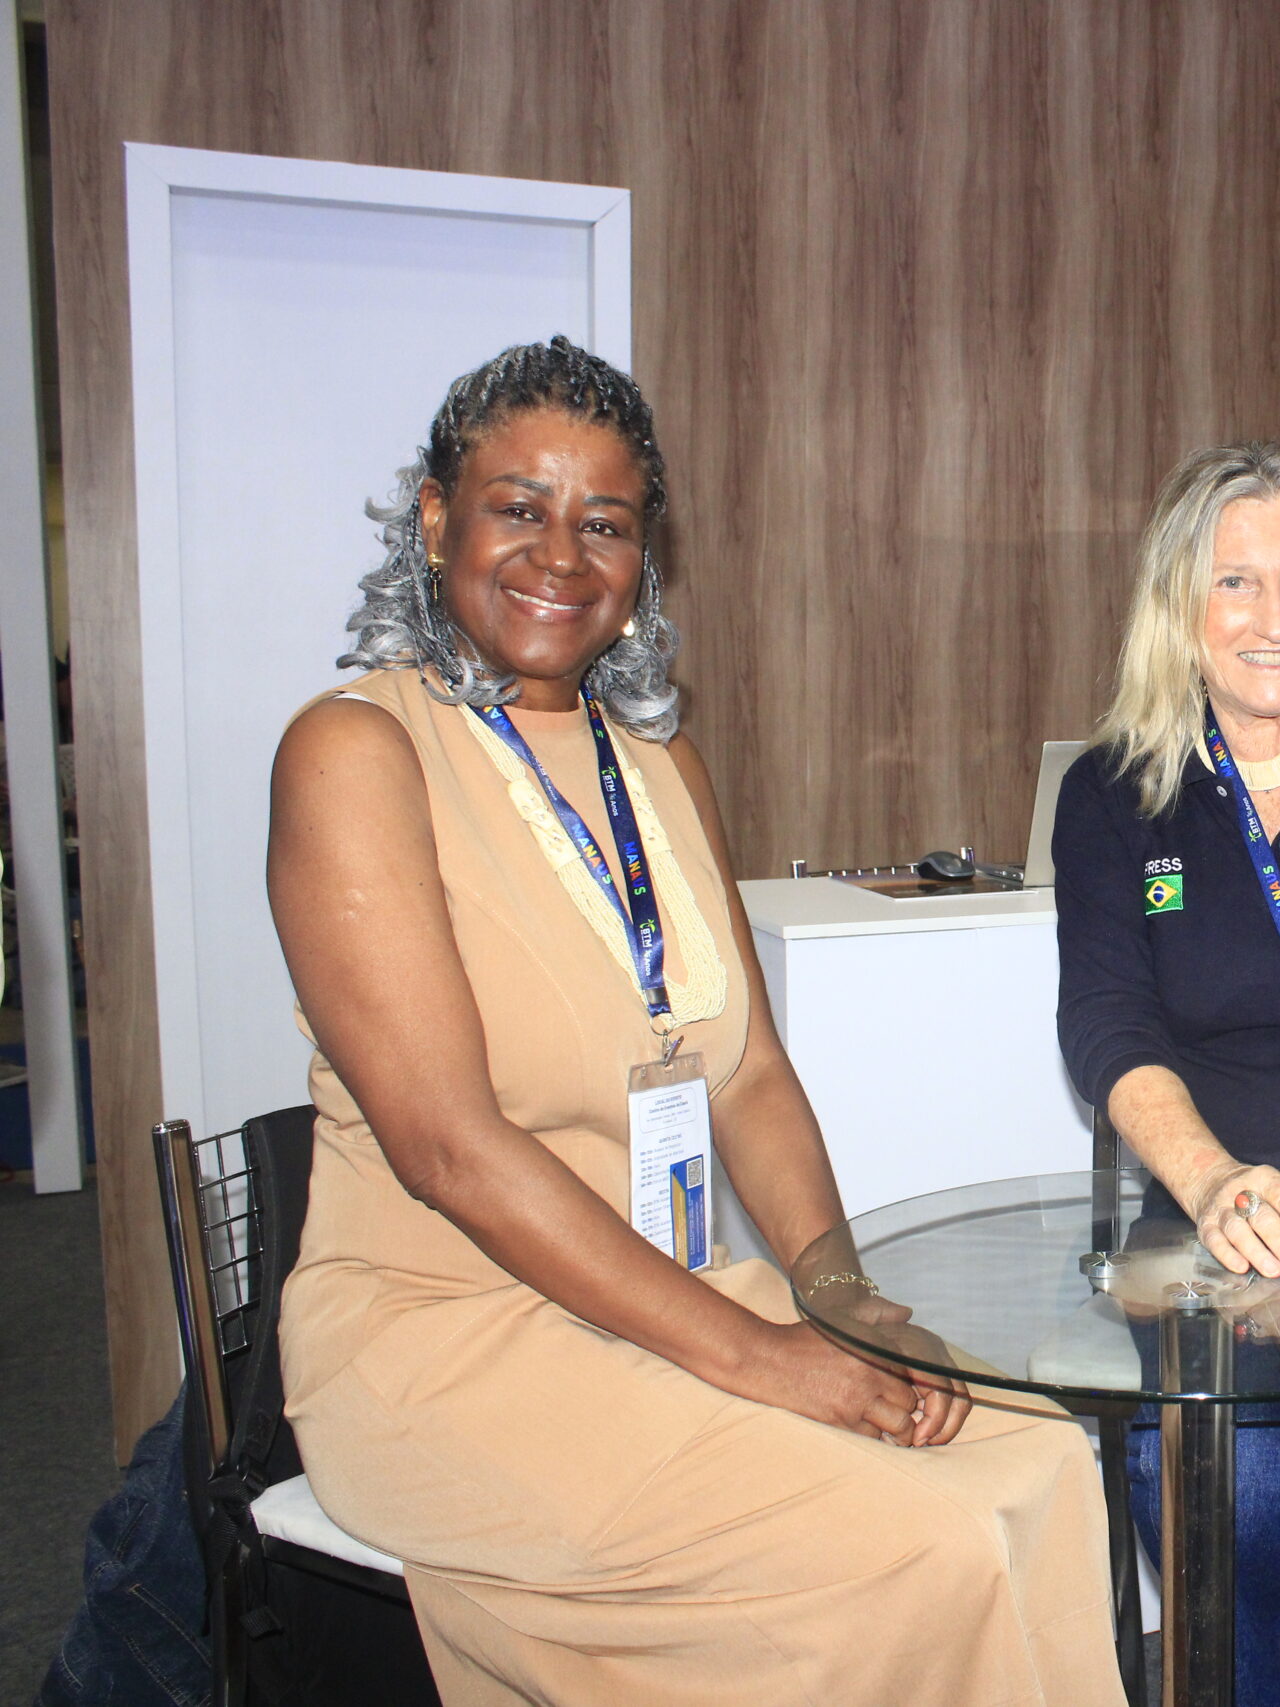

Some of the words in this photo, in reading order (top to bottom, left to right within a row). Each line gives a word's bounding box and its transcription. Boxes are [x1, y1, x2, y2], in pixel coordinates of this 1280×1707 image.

[1208, 729, 1235, 777] MANAUS
[604, 775, 616, 792] BTM
[1247, 817, 1260, 834] BTM
[571, 823, 613, 884] MANAUS
[624, 841, 646, 896] MANAUS
[641, 927, 653, 948] BTM
